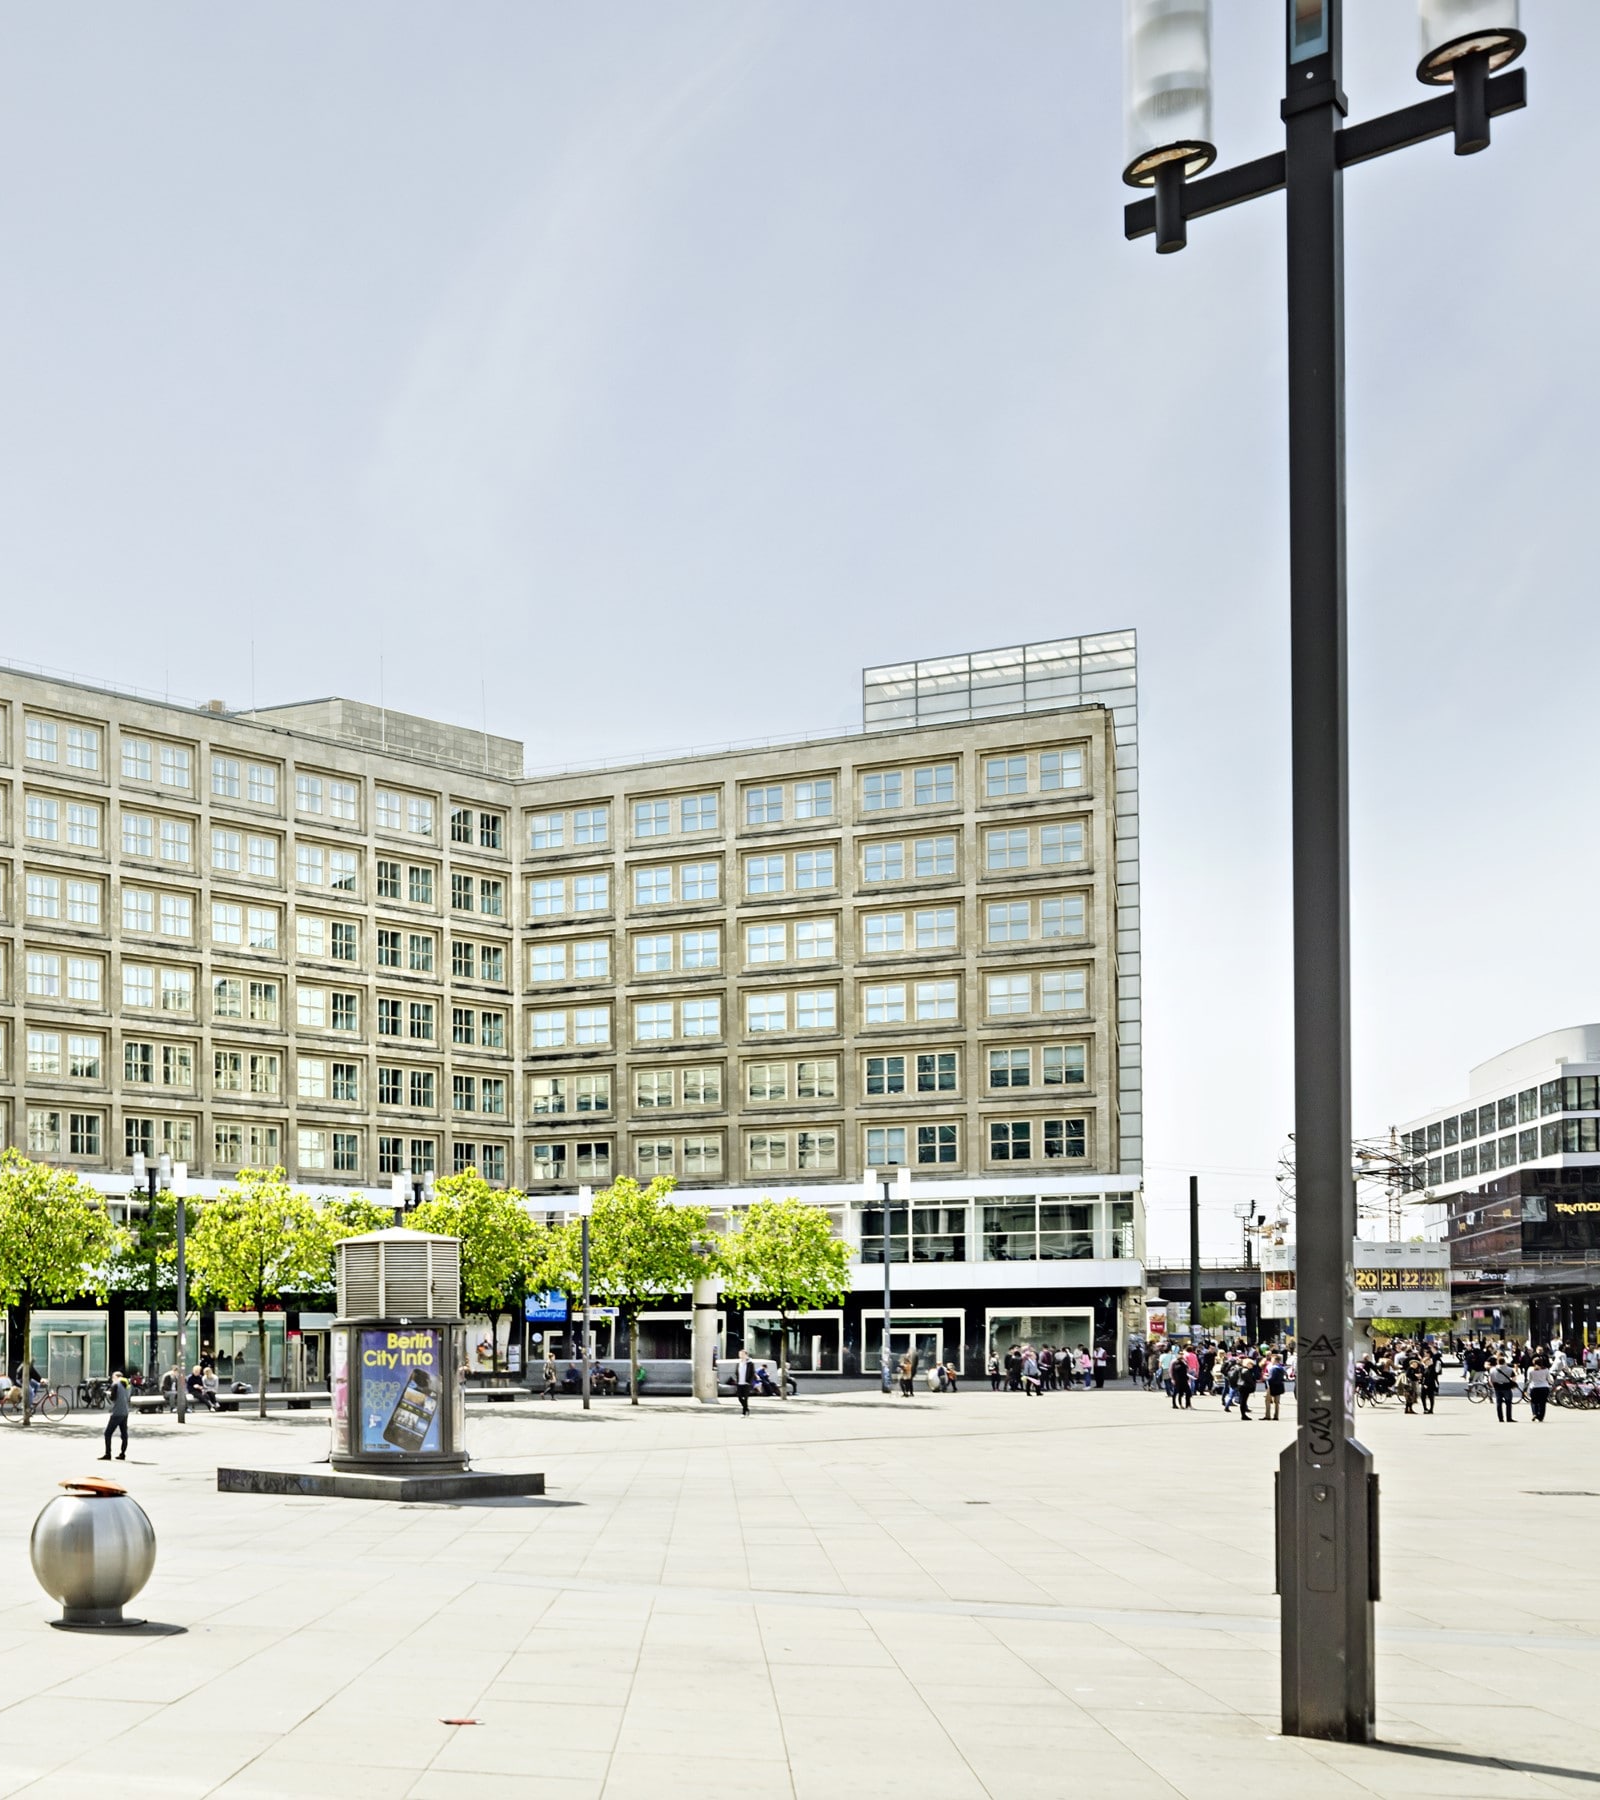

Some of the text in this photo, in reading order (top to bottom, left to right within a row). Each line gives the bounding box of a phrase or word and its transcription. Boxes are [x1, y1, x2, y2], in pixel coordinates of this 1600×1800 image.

[1355, 1272, 1378, 1286] 20
[1381, 1272, 1398, 1286] 21
[1402, 1272, 1420, 1286] 22
[1421, 1272, 1434, 1286] 23
[387, 1333, 432, 1349] Berlin
[363, 1350, 433, 1369] City Info
